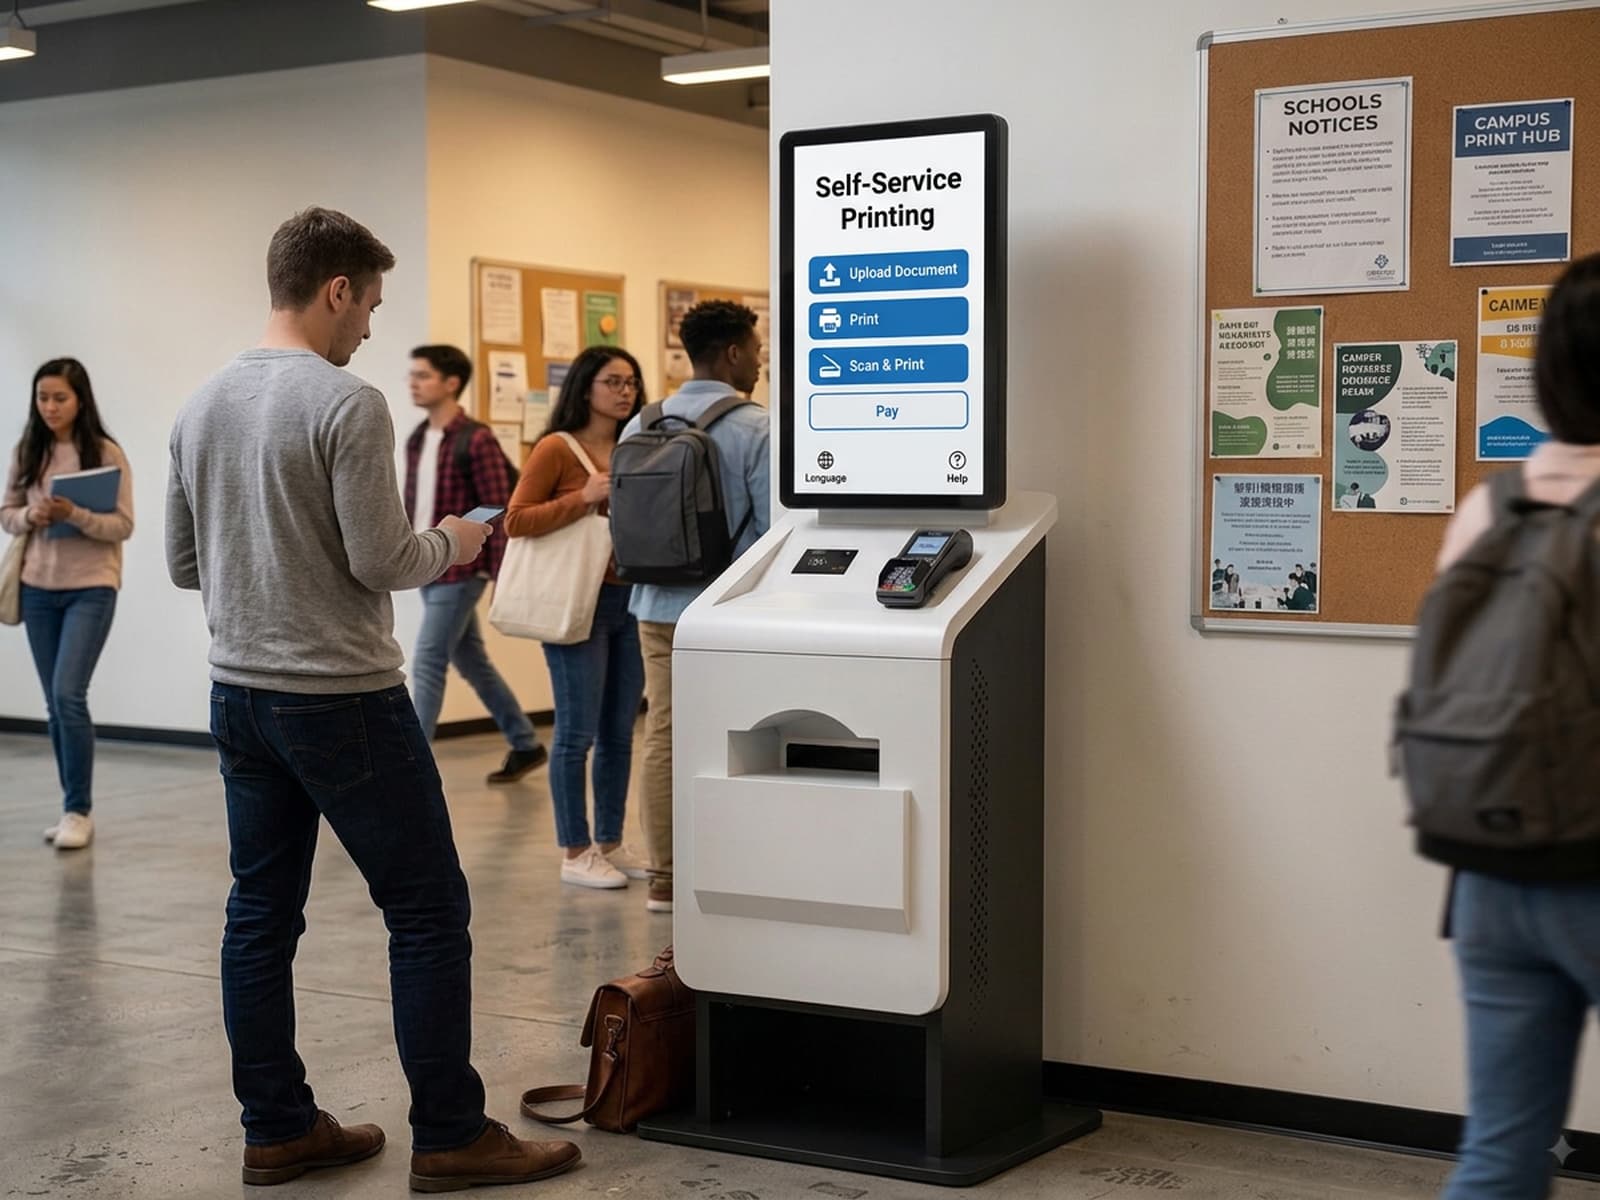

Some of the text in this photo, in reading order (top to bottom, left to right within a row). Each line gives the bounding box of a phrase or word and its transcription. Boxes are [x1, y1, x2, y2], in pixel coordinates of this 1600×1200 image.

[1284, 93, 1382, 116] SCHOOLS
[1288, 115, 1378, 136] NOTICES
[1475, 112, 1551, 130] CAMPUS
[1464, 129, 1561, 148] PRINT HUB
[816, 168, 962, 198] Self-Service
[841, 204, 935, 231] Printing
[849, 263, 958, 281] Upload Document
[849, 313, 880, 326] Print
[849, 358, 925, 372] Scan & Print
[876, 405, 899, 420] Pay
[946, 473, 969, 485] Help
